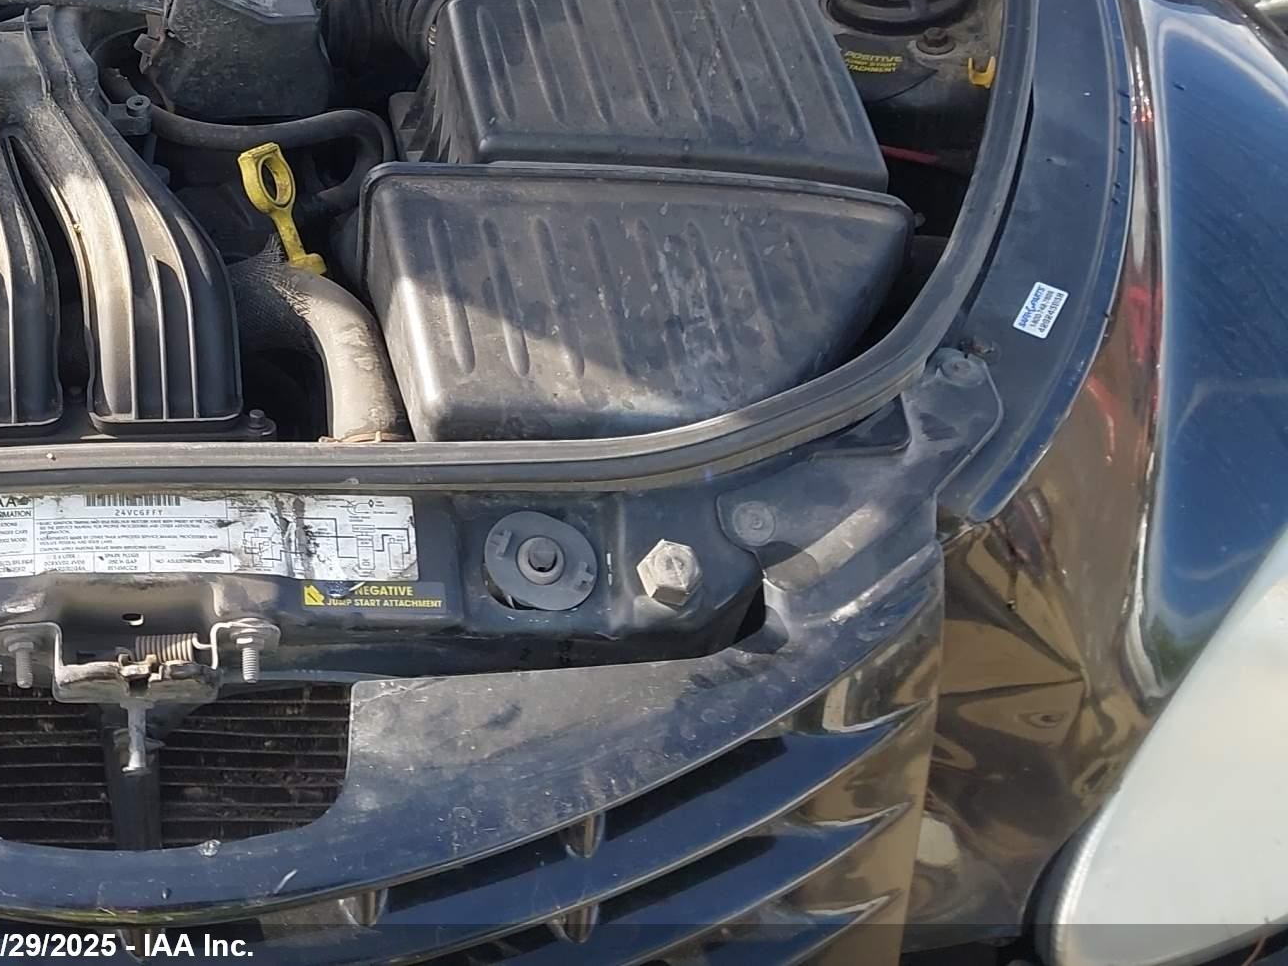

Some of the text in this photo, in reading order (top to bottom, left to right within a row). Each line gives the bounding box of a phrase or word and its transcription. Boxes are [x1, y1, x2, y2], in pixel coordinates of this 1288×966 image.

[844, 51, 903, 62] POSITIVE
[354, 585, 413, 596] NEGATIVE
[327, 598, 442, 608] JUMP START ATTACHMENT
